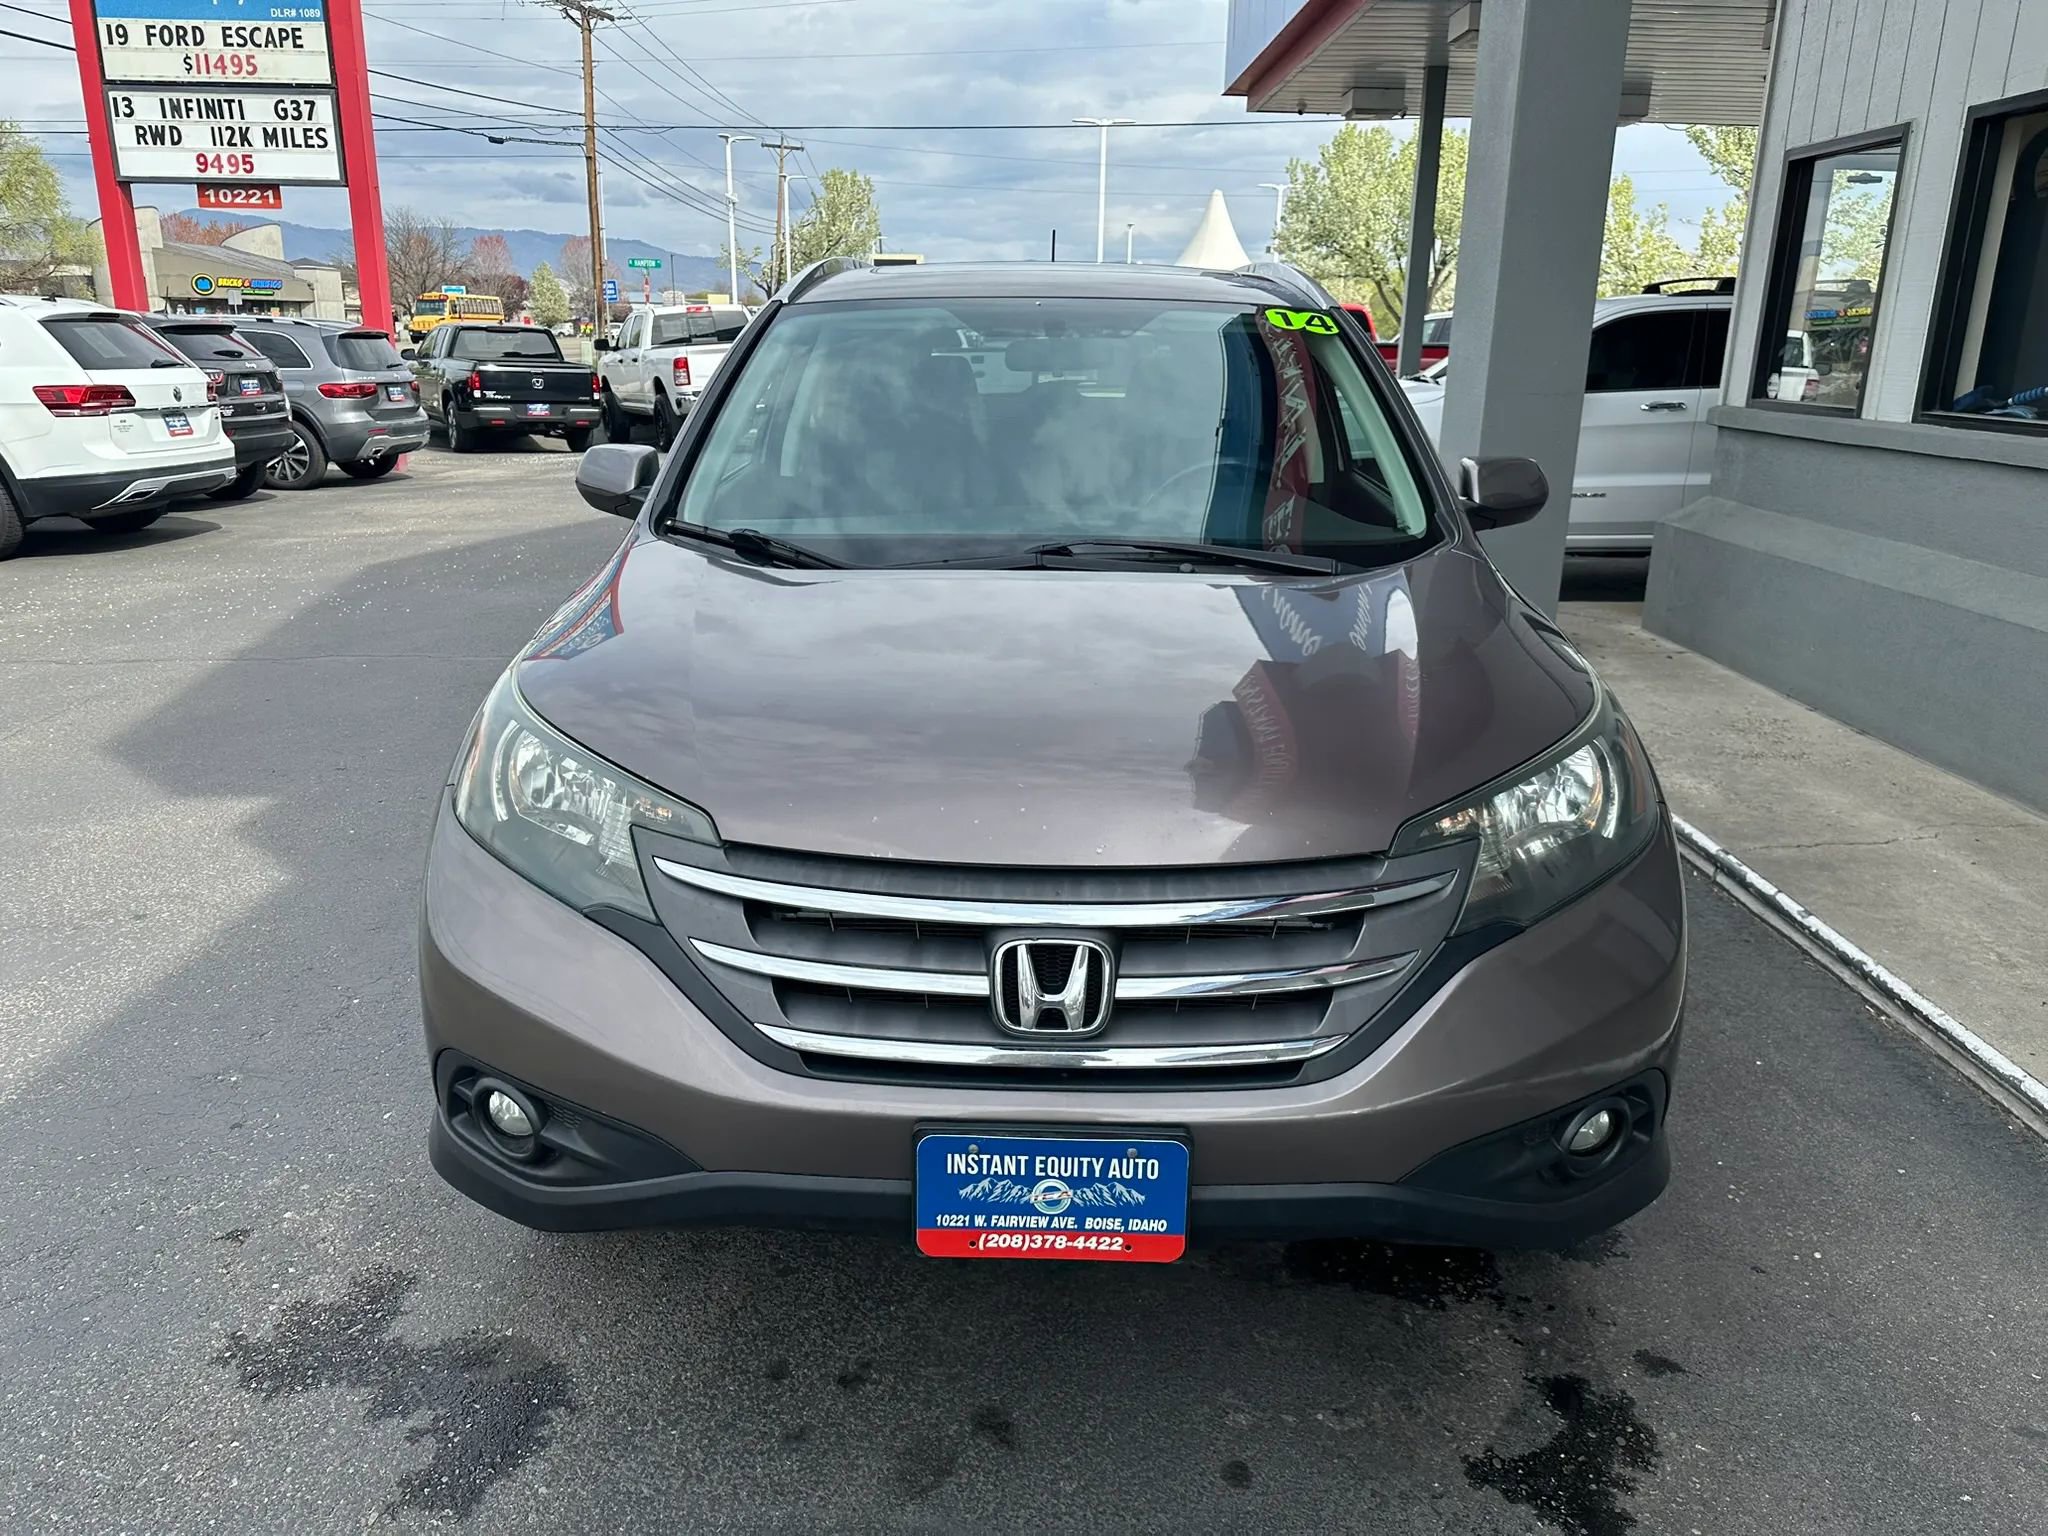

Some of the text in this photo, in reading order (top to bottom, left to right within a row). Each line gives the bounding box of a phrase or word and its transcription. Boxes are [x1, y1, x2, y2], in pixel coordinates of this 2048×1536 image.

[270, 8, 321, 18] DLR# 1089
[105, 23, 304, 49] 19 FORD ESCAPE
[183, 53, 258, 76] $11495
[112, 96, 316, 121] 13 INFINITI G37
[135, 125, 329, 149] RWD 112K MILES
[196, 152, 255, 175] 9495
[204, 188, 275, 205] 10221
[1274, 311, 1334, 332] 14
[947, 1153, 1159, 1180] INSTANT EQUITY AUTO
[936, 1214, 1168, 1232] 10221 W. FAIRVIEW AVE. BOISE, IDAHO
[978, 1233, 1123, 1251] (208)378-4422
